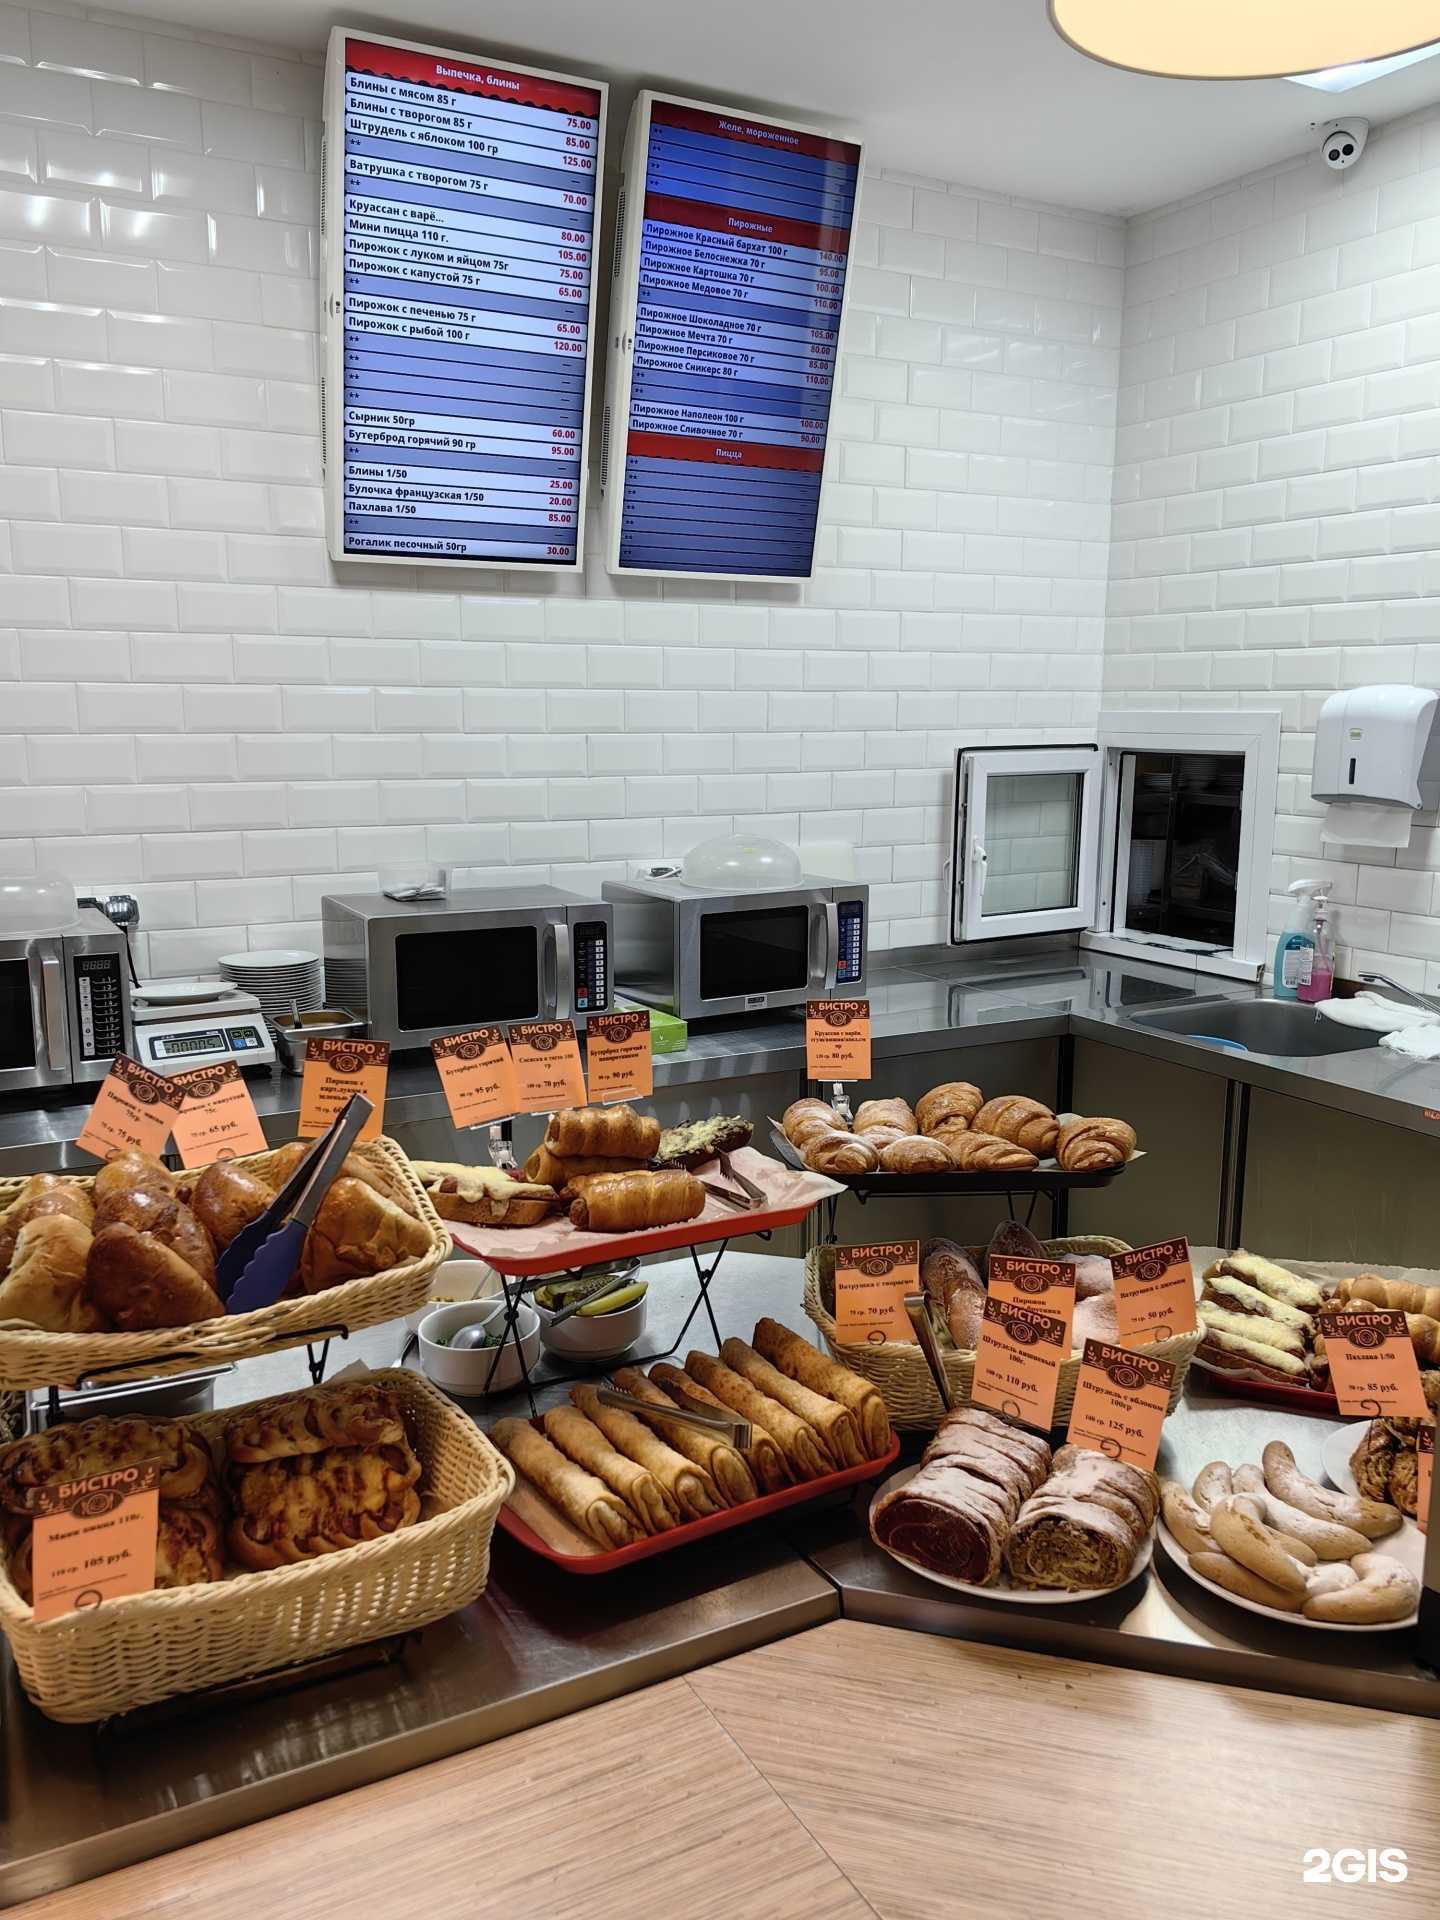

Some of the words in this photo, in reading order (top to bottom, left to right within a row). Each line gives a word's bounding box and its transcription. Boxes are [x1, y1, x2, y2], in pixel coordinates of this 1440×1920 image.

[435, 64, 484, 84] Выпечка,
[486, 74, 519, 90] блины
[350, 76, 388, 93] Блины
[398, 88, 434, 102] мясом
[436, 93, 449, 105] 85
[566, 117, 591, 130] 75.00
[350, 97, 388, 114] Блины
[398, 108, 451, 125] творогом
[452, 116, 465, 128] 85
[565, 136, 590, 149] 85.00
[718, 120, 744, 134] Желе,
[745, 127, 799, 145] мороженное
[350, 117, 407, 137] Штрудель
[417, 131, 465, 148] яблоком
[467, 139, 485, 151] 100
[487, 144, 498, 156] гр
[562, 155, 592, 169] 125.00
[349, 158, 405, 177] Ватрушка
[415, 171, 467, 188] творогом
[469, 178, 481, 190] 75
[562, 193, 587, 206] 70.00
[349, 198, 400, 216] Круассан
[560, 231, 585, 243] 80.00
[728, 217, 773, 233] Пирожные
[349, 218, 381, 232] Мини
[383, 225, 418, 239] пицца
[421, 229, 439, 241] 110
[557, 249, 587, 262] 105.00
[646, 223, 694, 240] Пирожное
[695, 231, 734, 247] Красный
[735, 238, 766, 253] бархат
[767, 244, 782, 255] 100
[348, 238, 400, 255] Пирожок
[409, 249, 444, 261] луком
[456, 254, 491, 268] яйцом
[493, 259, 509, 271] 75г
[559, 268, 583, 280] 75.00
[645, 239, 692, 256] Пирожное
[694, 248, 748, 266] Белоснежка
[749, 257, 760, 268] 70
[348, 257, 400, 274] Пирожок
[410, 268, 460, 283] капустой
[461, 273, 473, 284] 75
[558, 286, 582, 298] 65.00
[643, 256, 691, 273] Пирожное
[692, 265, 737, 280] Картошка
[738, 272, 749, 282] 70
[642, 273, 690, 290] Пирожное
[691, 281, 731, 296] Медовое
[732, 287, 743, 298] 70
[348, 296, 399, 312] Пирожок
[409, 306, 455, 320] печенью
[457, 311, 469, 321] 75
[556, 323, 580, 334] 65.00
[640, 306, 687, 322] Пирожное
[688, 313, 745, 330] Шоколадное
[746, 322, 756, 332] 70
[348, 315, 399, 332] Пирожок
[409, 325, 443, 337] рыбой
[446, 328, 463, 339] 100
[553, 340, 582, 352] 120.00
[639, 323, 686, 338] Пирожное
[687, 329, 716, 342] Мечта
[716, 334, 727, 344] 70
[637, 339, 685, 354] Пирожное
[686, 345, 738, 361] Персиковое
[739, 352, 749, 362] 70
[636, 355, 683, 370] Пирожное
[684, 361, 721, 375] Сникерс
[722, 366, 732, 376] 80
[633, 403, 679, 417] Пирожное
[680, 408, 723, 421] Наполеон
[724, 413, 738, 423] 100
[348, 410, 390, 423] Сырник
[392, 414, 415, 428] 50гр
[552, 428, 575, 439] 60.00
[632, 418, 678, 432] Пирожное
[679, 423, 727, 437] Сливочное
[727, 429, 737, 438] 70
[348, 428, 405, 445] Бутерброд
[407, 435, 450, 446] горячий
[451, 438, 463, 448] 90
[465, 441, 476, 451] гр
[551, 445, 574, 456] 95.00
[715, 447, 742, 459] Пицца
[348, 465, 384, 477] Блины
[386, 468, 407, 479] 1/50
[549, 479, 573, 490] 25.00
[348, 483, 392, 495] Булочка
[394, 486, 462, 500] французская
[463, 491, 484, 501] 1/50
[548, 496, 572, 506] 20.00
[348, 501, 393, 512] Пахлава
[395, 504, 416, 514] 1/50
[548, 513, 571, 522] 85.00
[348, 536, 392, 547] Рогалик
[393, 540, 443, 550] песочный
[445, 541, 467, 553] 50гр
[546, 546, 569, 556] 30.00
[819, 1002, 858, 1011] БИСТРО
[521, 1024, 562, 1035] БИСТРО
[599, 1014, 639, 1026] БИСТРО
[322, 1040, 375, 1054] БИСТРО
[443, 1029, 489, 1047] БИСТРО
[840, 1053, 854, 1061] руб.
[127, 1063, 174, 1093] БИСТРО
[173, 1066, 226, 1086] БИСТРО
[552, 1080, 567, 1088] руб.
[485, 1083, 501, 1094] руб.
[118, 1129, 126, 1138] 75
[221, 1121, 238, 1132] руб.
[851, 1245, 903, 1258] БИСТРО
[1125, 1245, 1173, 1265] БИСТРО
[1006, 1261, 1060, 1275] БИСТРО
[879, 1306, 896, 1315] руб.
[1000, 1303, 1051, 1329] БИСТРО
[1159, 1306, 1175, 1318] руб.
[1336, 1314, 1392, 1326] БИСТРО
[1102, 1347, 1159, 1373] БИСТРО
[1006, 1375, 1020, 1386] 110
[1021, 1381, 1039, 1392] руб.
[1083, 1380, 1121, 1399] Штрудель
[1380, 1384, 1398, 1392] руб.
[1109, 1419, 1124, 1431] 125
[1125, 1426, 1144, 1438] руб.
[59, 1468, 138, 1498] БИСТРО
[85, 1557, 105, 1568] 105
[107, 1549, 131, 1565] руб.
